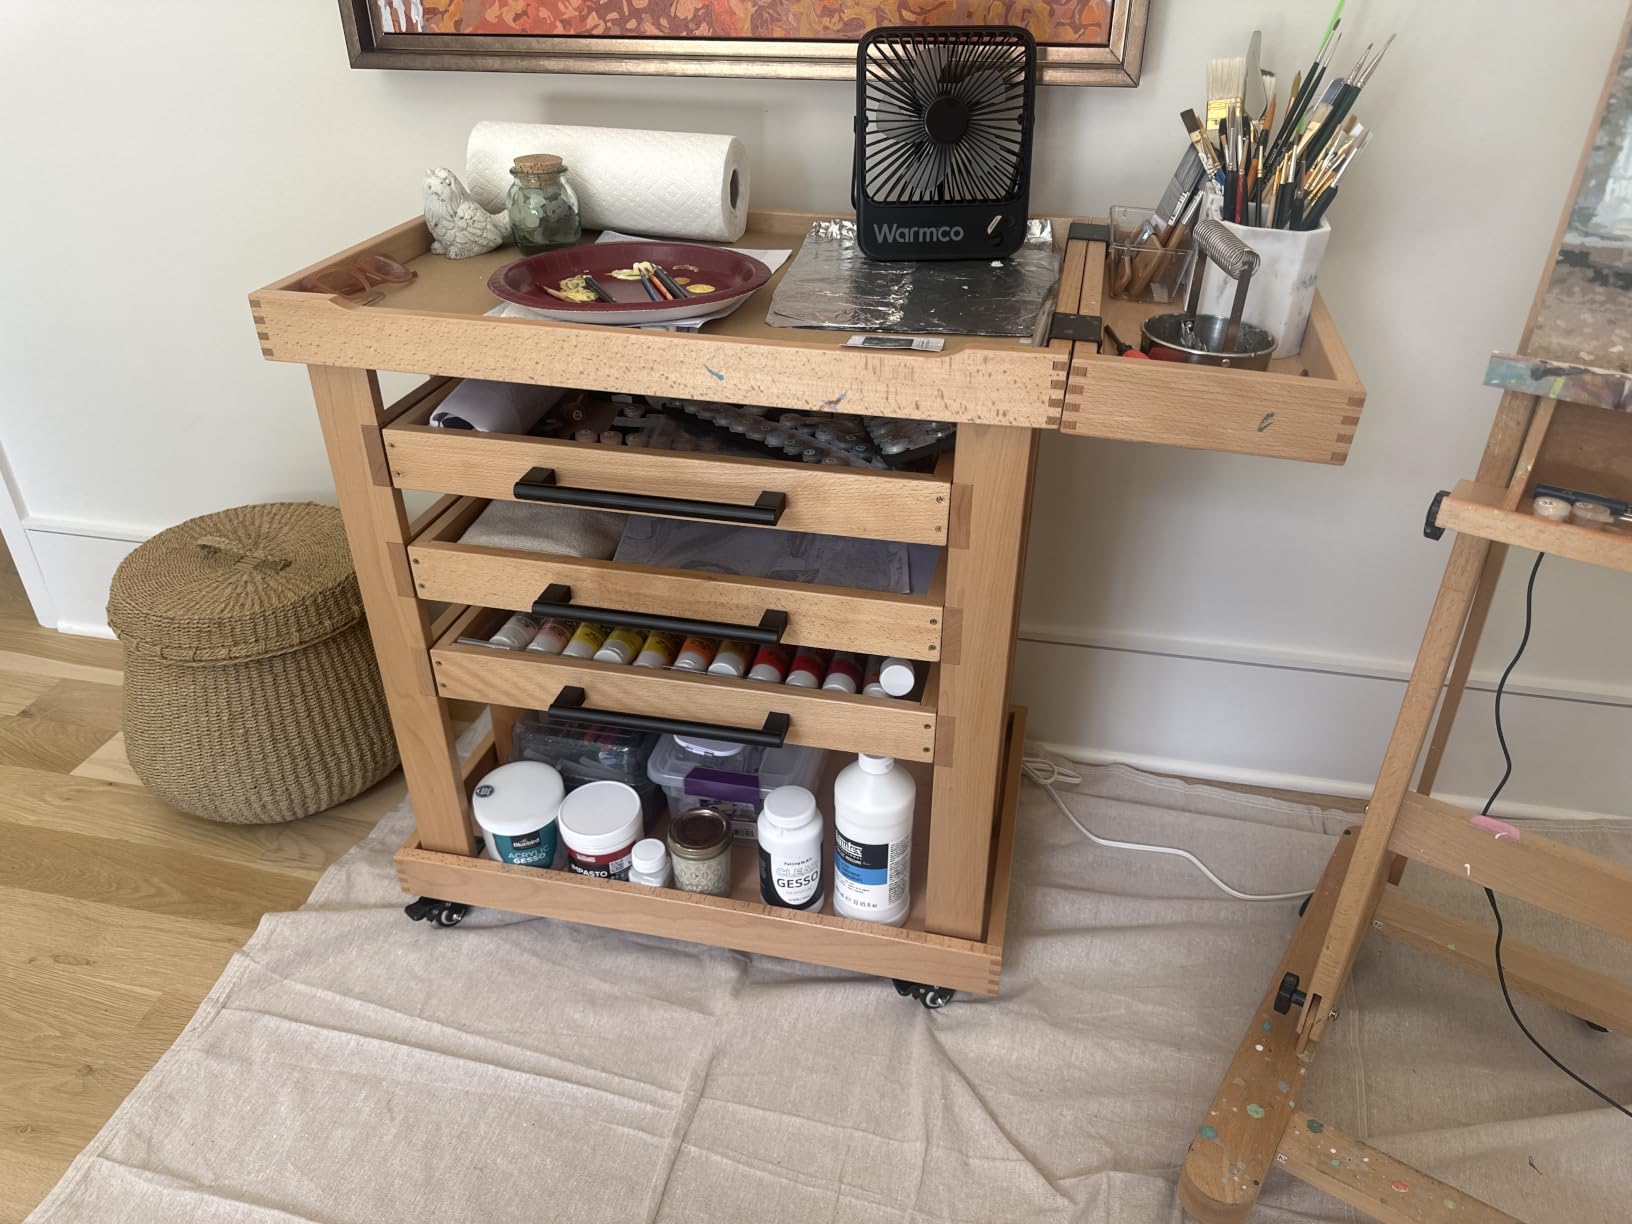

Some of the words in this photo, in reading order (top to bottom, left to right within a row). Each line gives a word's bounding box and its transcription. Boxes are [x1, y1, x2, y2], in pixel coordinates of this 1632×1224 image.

[873, 223, 964, 243] Warmco
[508, 844, 550, 858] ACRYLIC
[513, 852, 546, 864] GESSO
[571, 863, 608, 877] IMPASTO
[776, 862, 818, 878] CLEAR
[776, 870, 819, 888] GESSO
